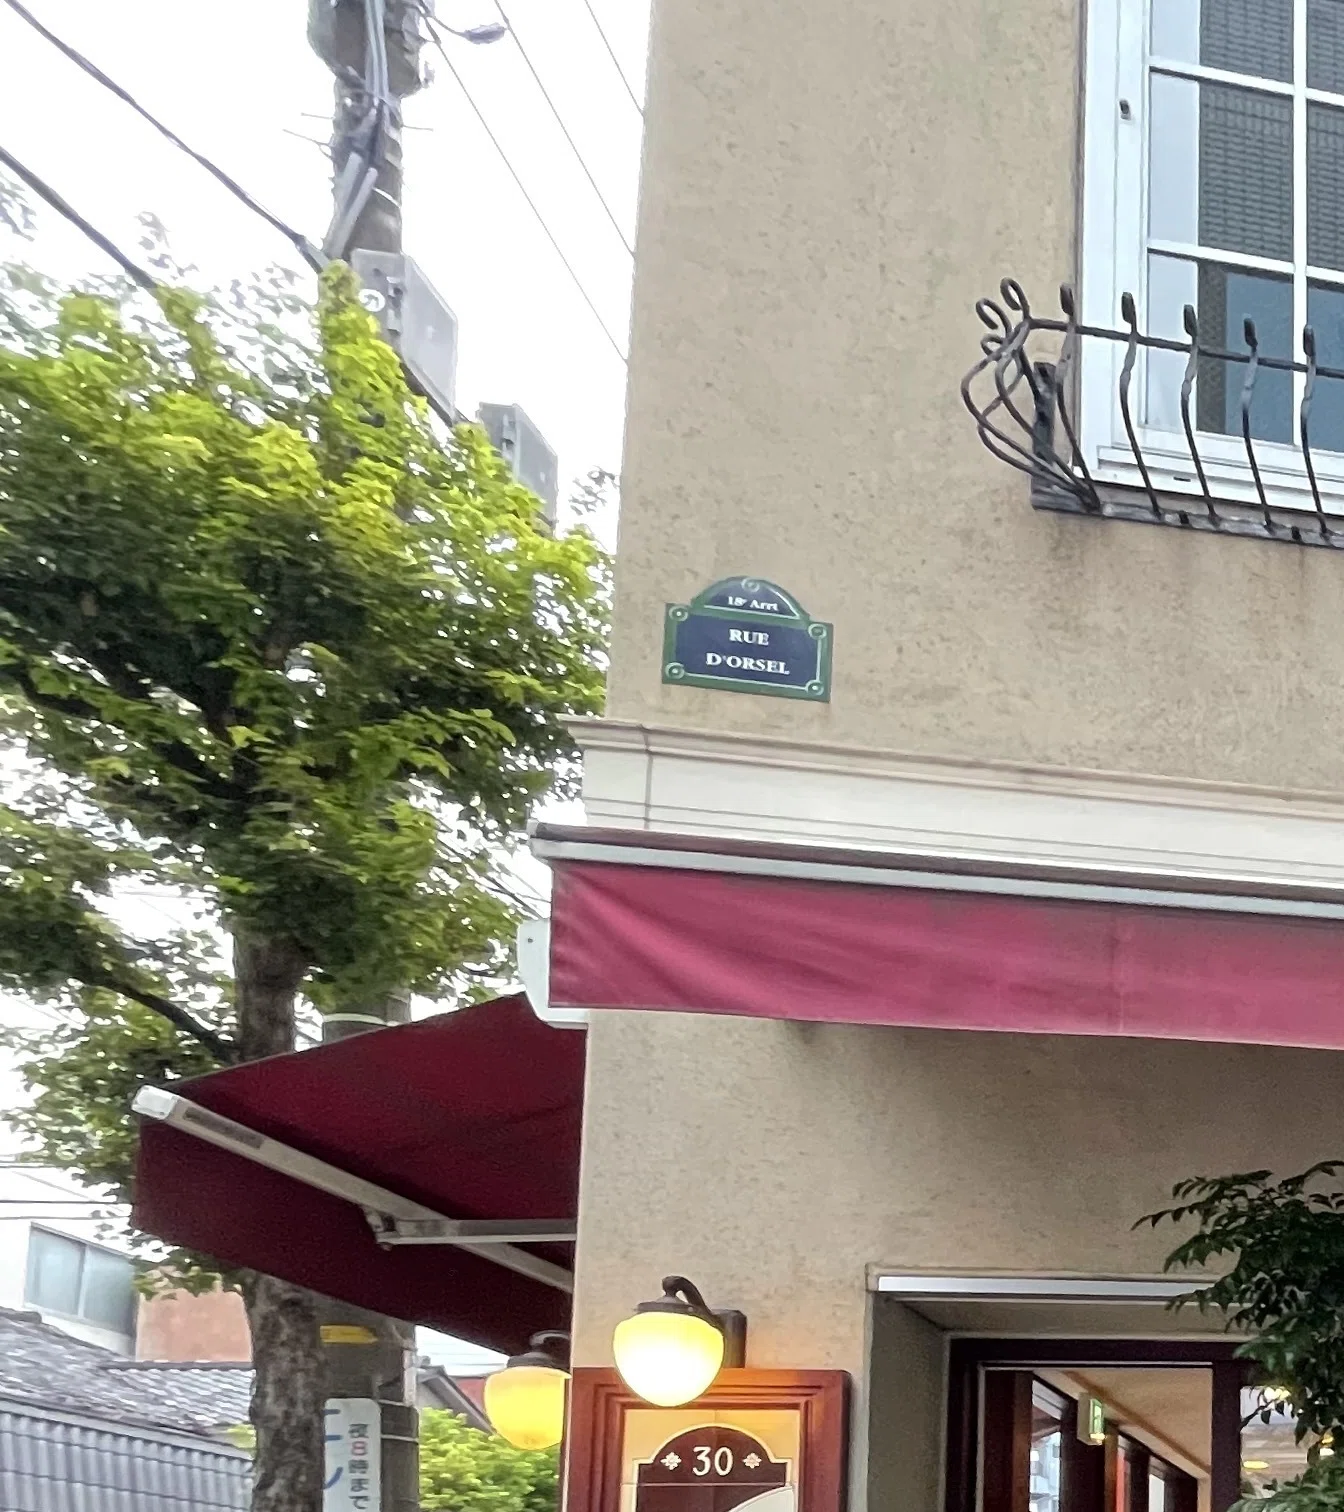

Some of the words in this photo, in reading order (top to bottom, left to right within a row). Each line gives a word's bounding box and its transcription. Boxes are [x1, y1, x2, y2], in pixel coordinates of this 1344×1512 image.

[729, 628, 769, 646] RUE
[706, 652, 790, 676] D'ORSEL
[692, 1446, 734, 1476] 30
